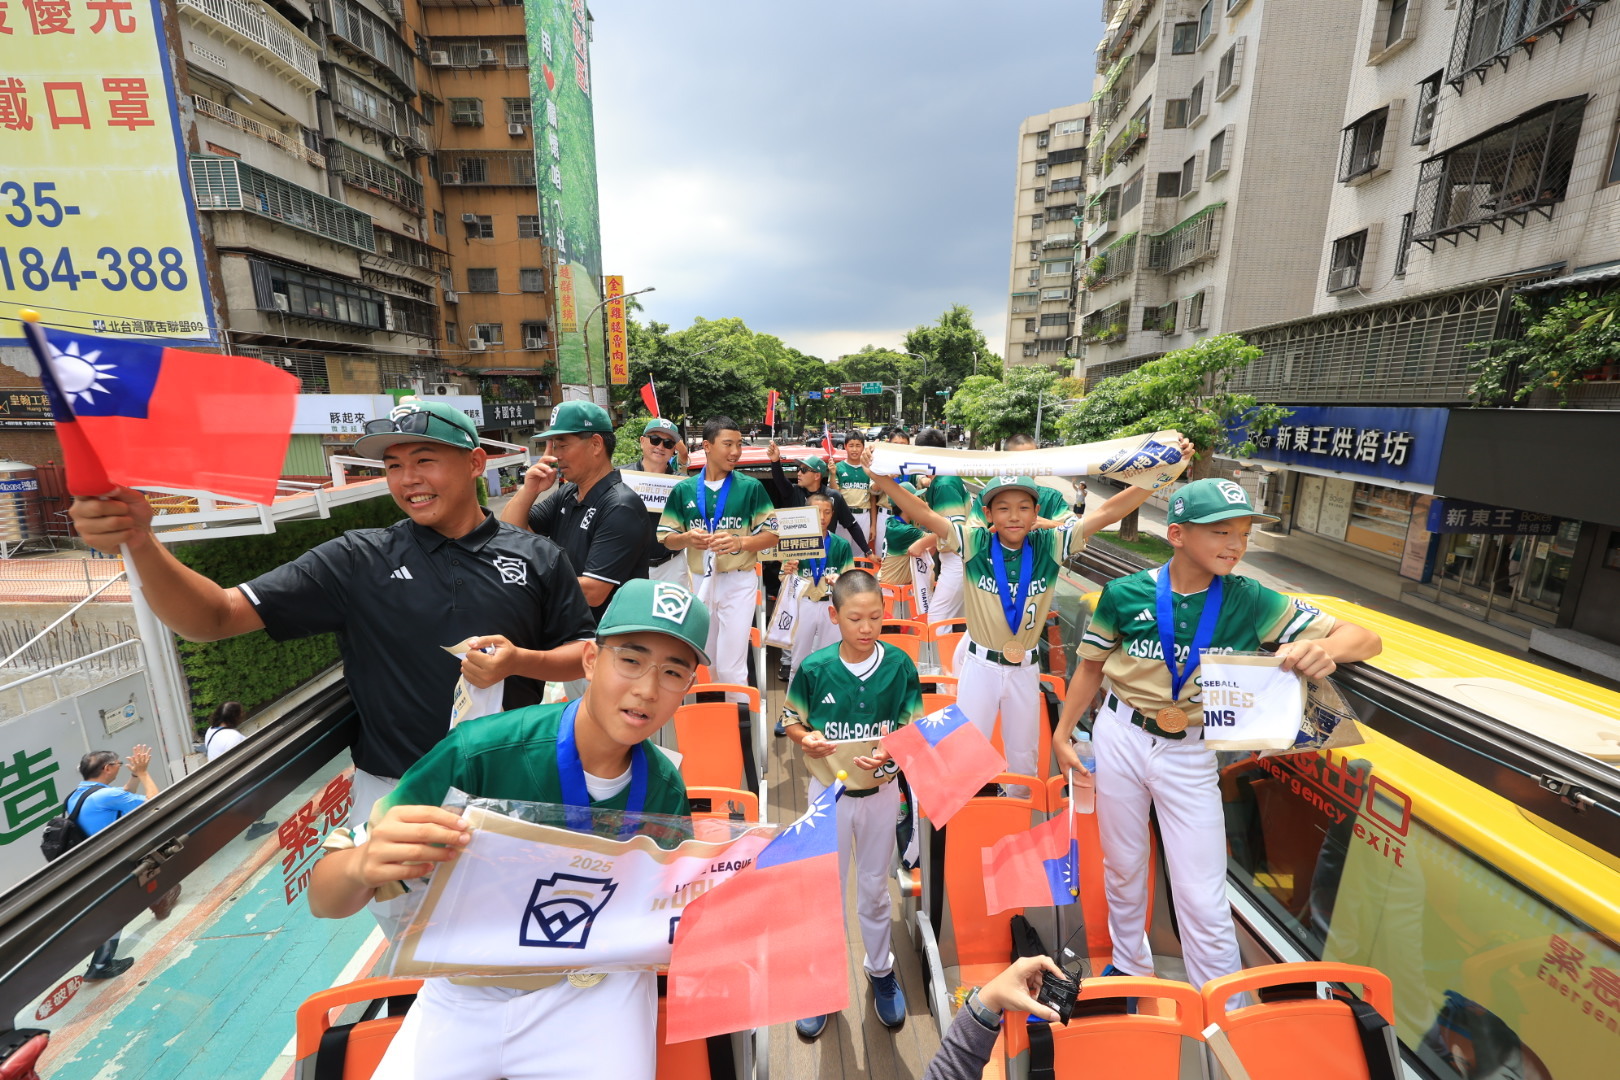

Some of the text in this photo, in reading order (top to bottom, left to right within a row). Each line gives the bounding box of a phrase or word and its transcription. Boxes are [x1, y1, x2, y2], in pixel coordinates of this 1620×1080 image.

[330, 412, 366, 424] 豚起來
[331, 425, 365, 433] 微型超
[1275, 425, 1415, 466] 新東王烘焙坊
[1445, 508, 1515, 528] 新東王
[1353, 822, 1405, 868] exit
[568, 854, 615, 873] 2025
[1537, 963, 1620, 1037] Emergen
